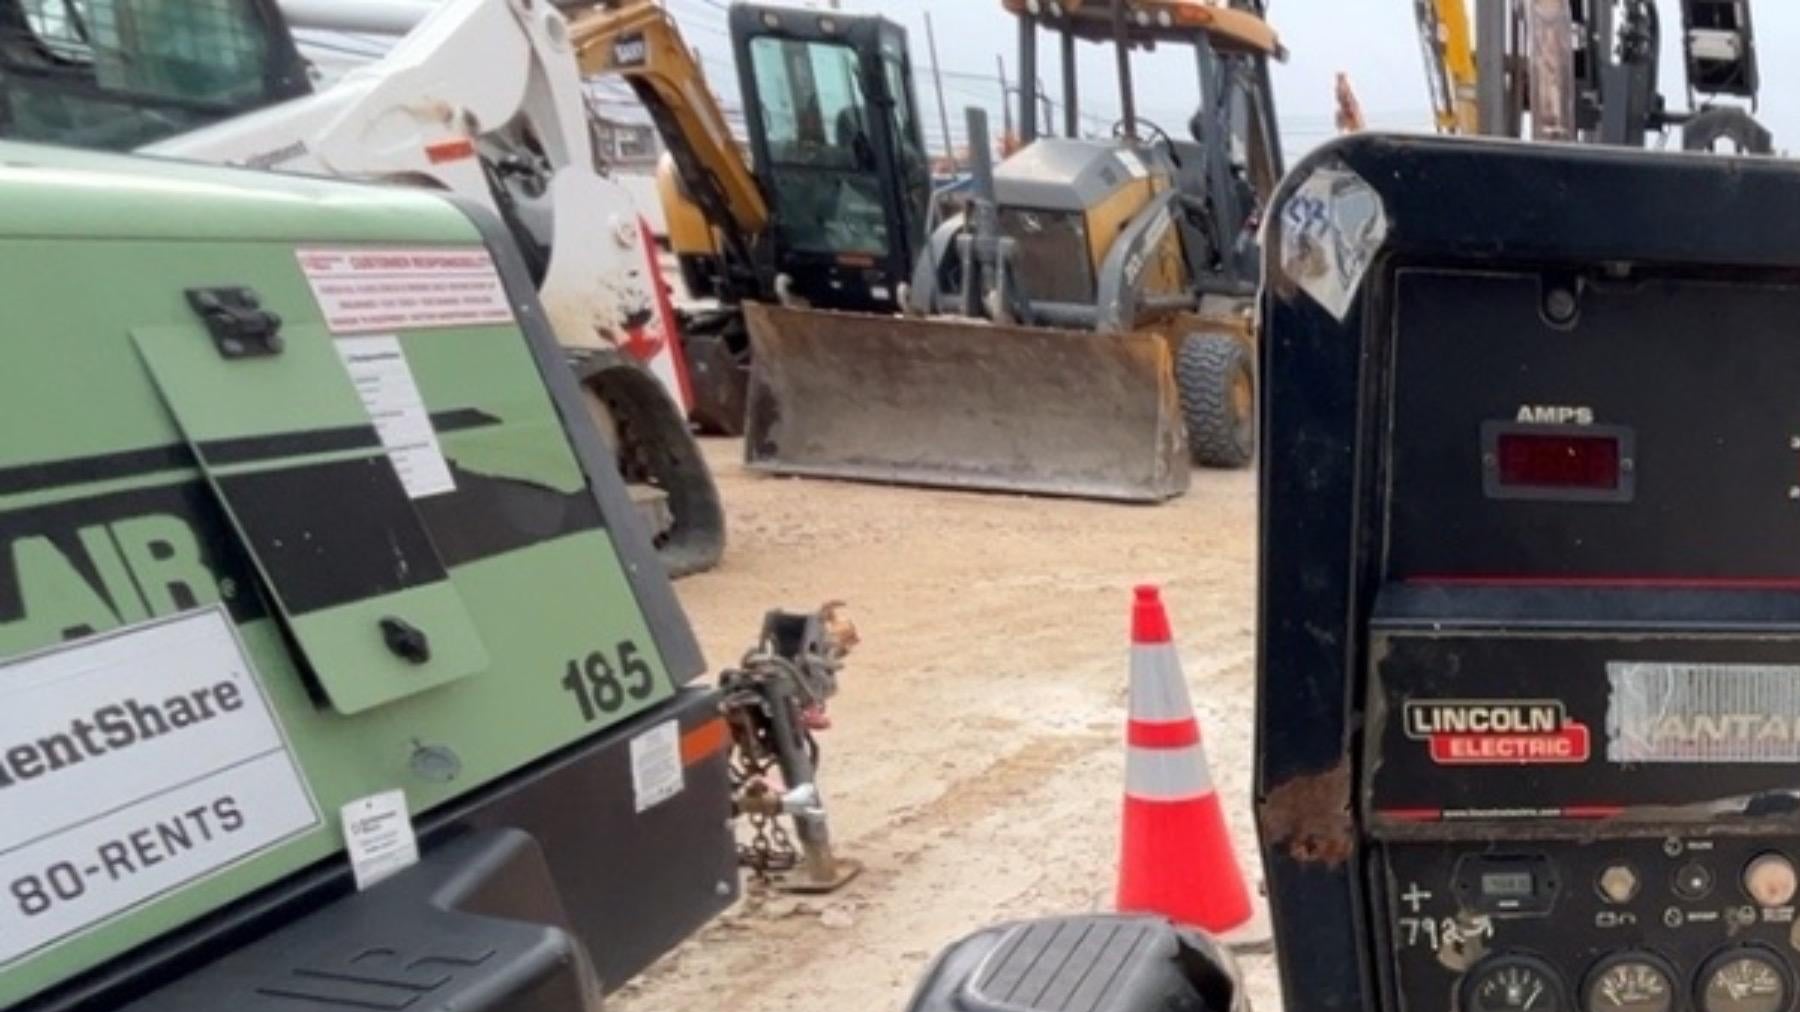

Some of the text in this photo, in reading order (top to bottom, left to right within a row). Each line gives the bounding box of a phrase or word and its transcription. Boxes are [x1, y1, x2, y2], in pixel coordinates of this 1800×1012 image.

[1515, 404, 1594, 426] AMPS
[0, 513, 222, 655] AIR
[562, 640, 654, 722] 185
[1414, 706, 1574, 757] LINCOLN ELECTRIC
[10, 796, 243, 916] 80-RENTS
